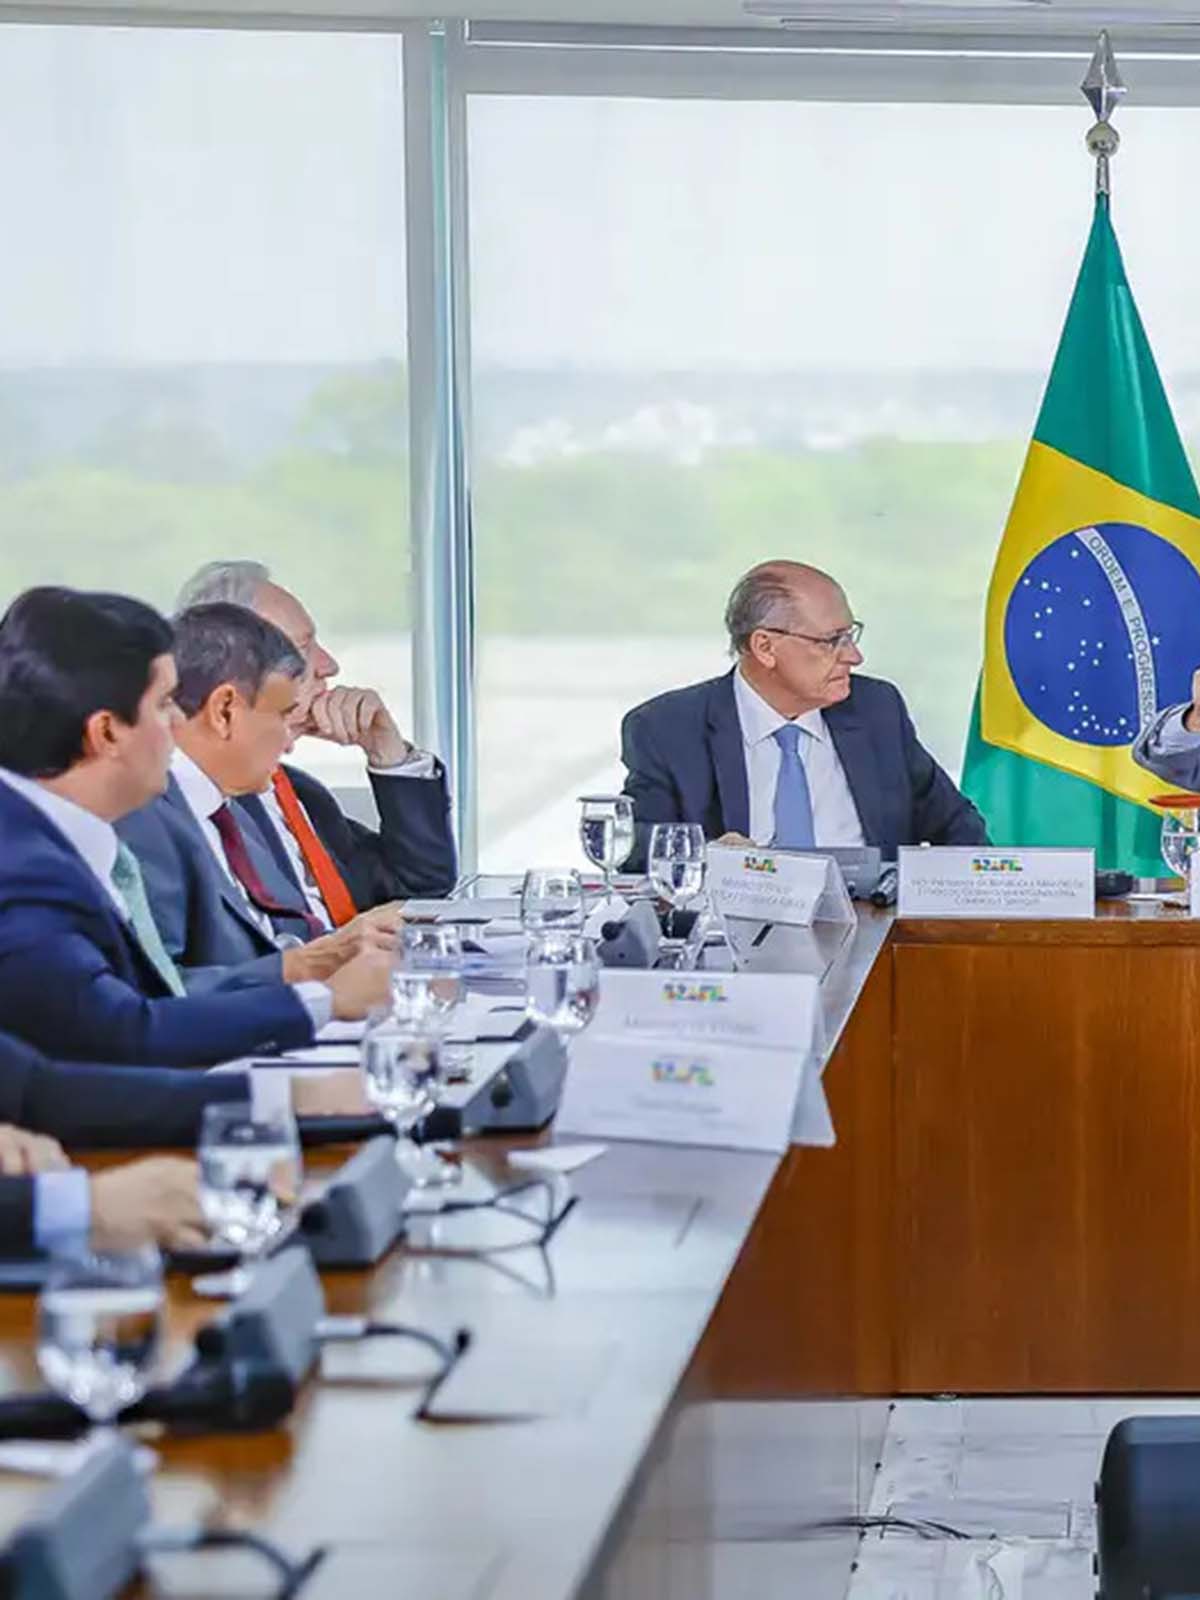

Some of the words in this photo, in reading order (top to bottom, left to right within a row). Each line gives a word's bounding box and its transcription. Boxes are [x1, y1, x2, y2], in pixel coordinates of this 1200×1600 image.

[1088, 535, 1127, 593] ORDEM
[1123, 598, 1135, 609] E
[1128, 615, 1154, 726] PROGRESSO
